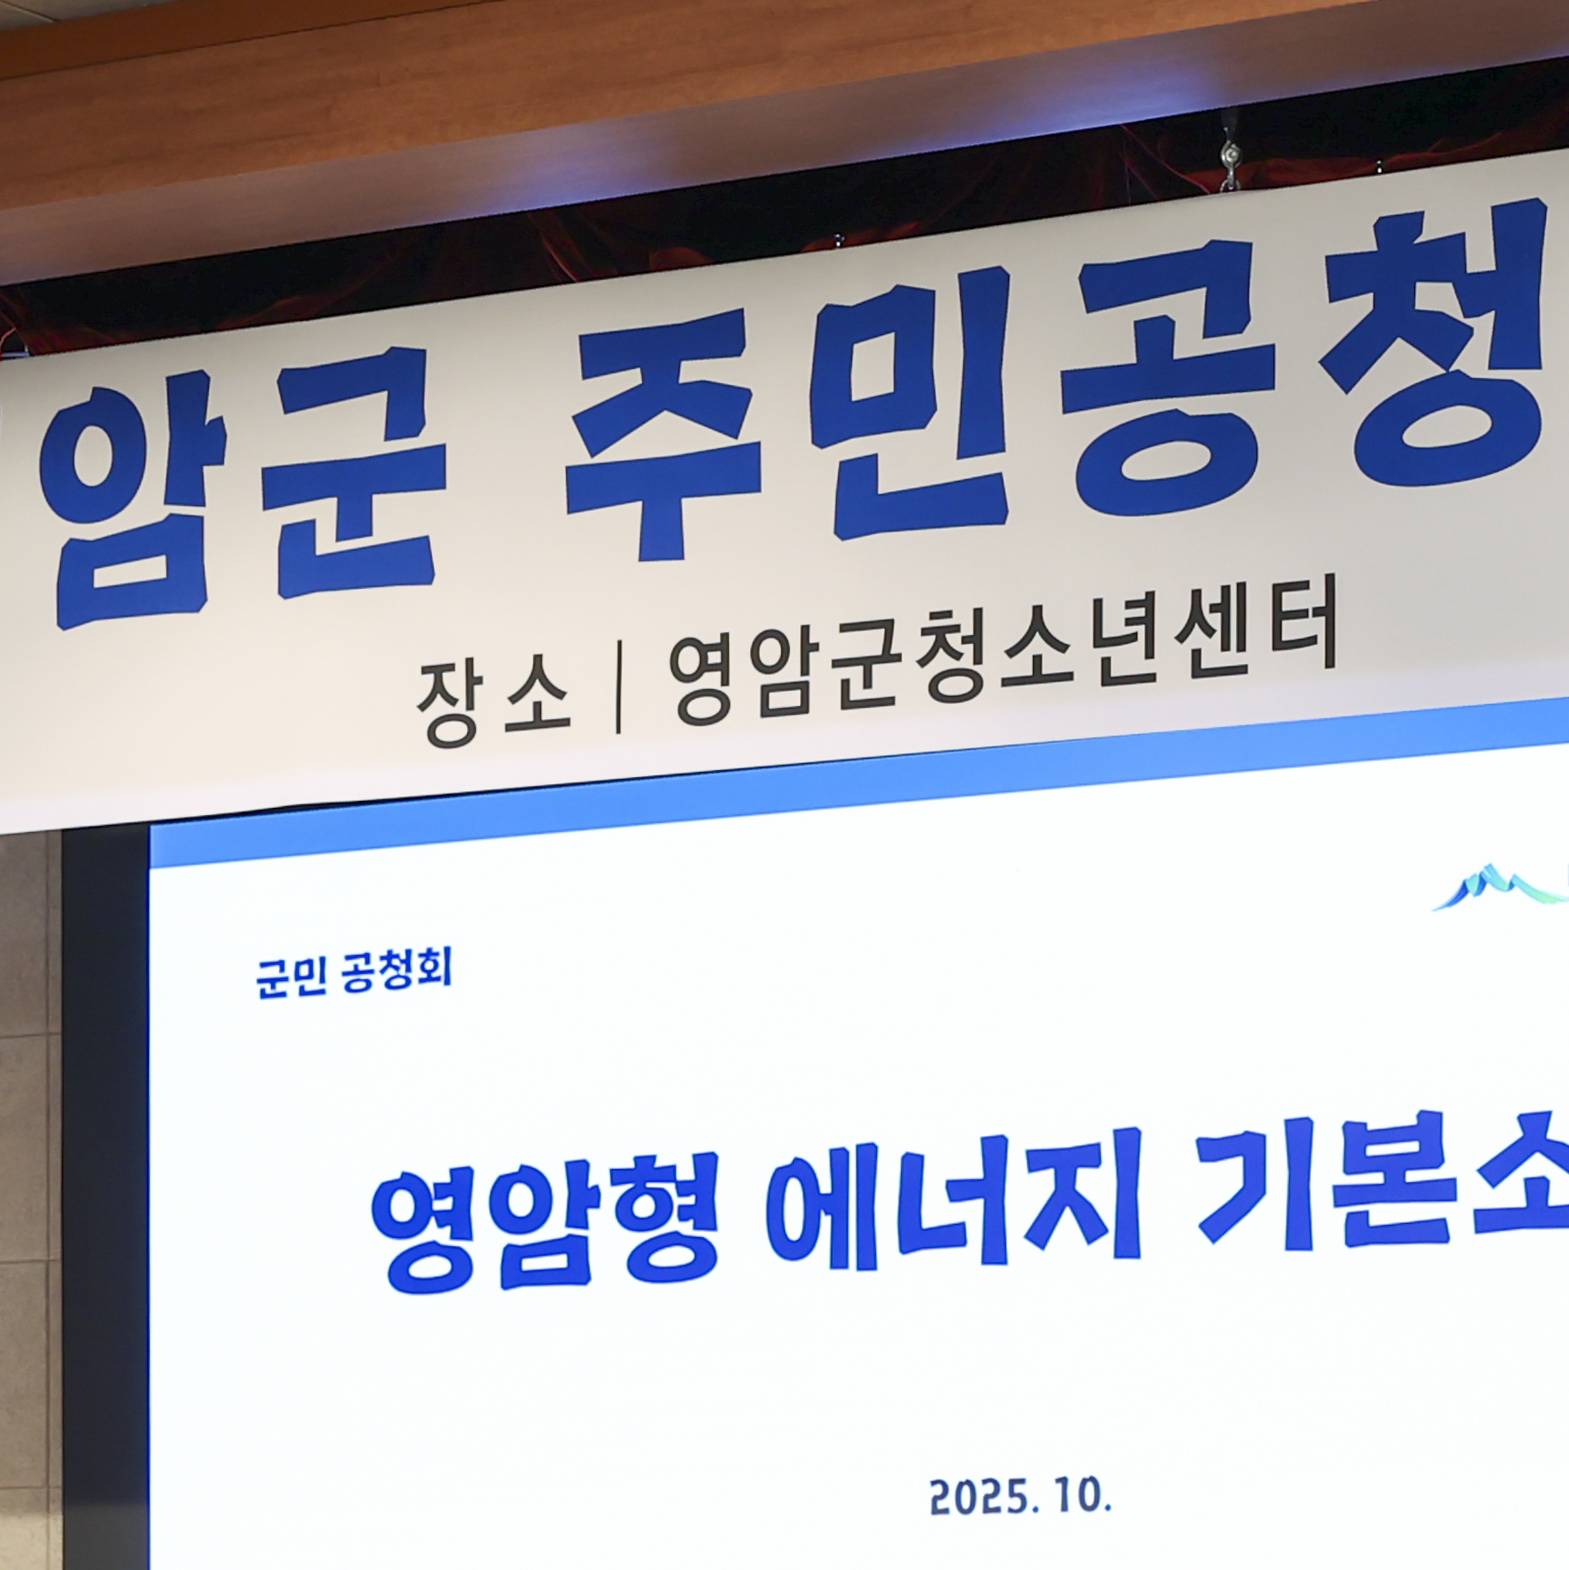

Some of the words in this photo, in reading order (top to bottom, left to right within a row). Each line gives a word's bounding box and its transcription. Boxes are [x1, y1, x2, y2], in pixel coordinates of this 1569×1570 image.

[415, 652, 572, 750] 장소
[668, 571, 1337, 727] 영암군청소년센터
[256, 955, 327, 1000] 군민
[341, 945, 452, 994] 공청회
[370, 1150, 720, 1296] 영암형
[765, 1126, 1143, 1272] 에너지
[929, 1477, 1040, 1516] 2025.
[1054, 1475, 1113, 1513] 10.
